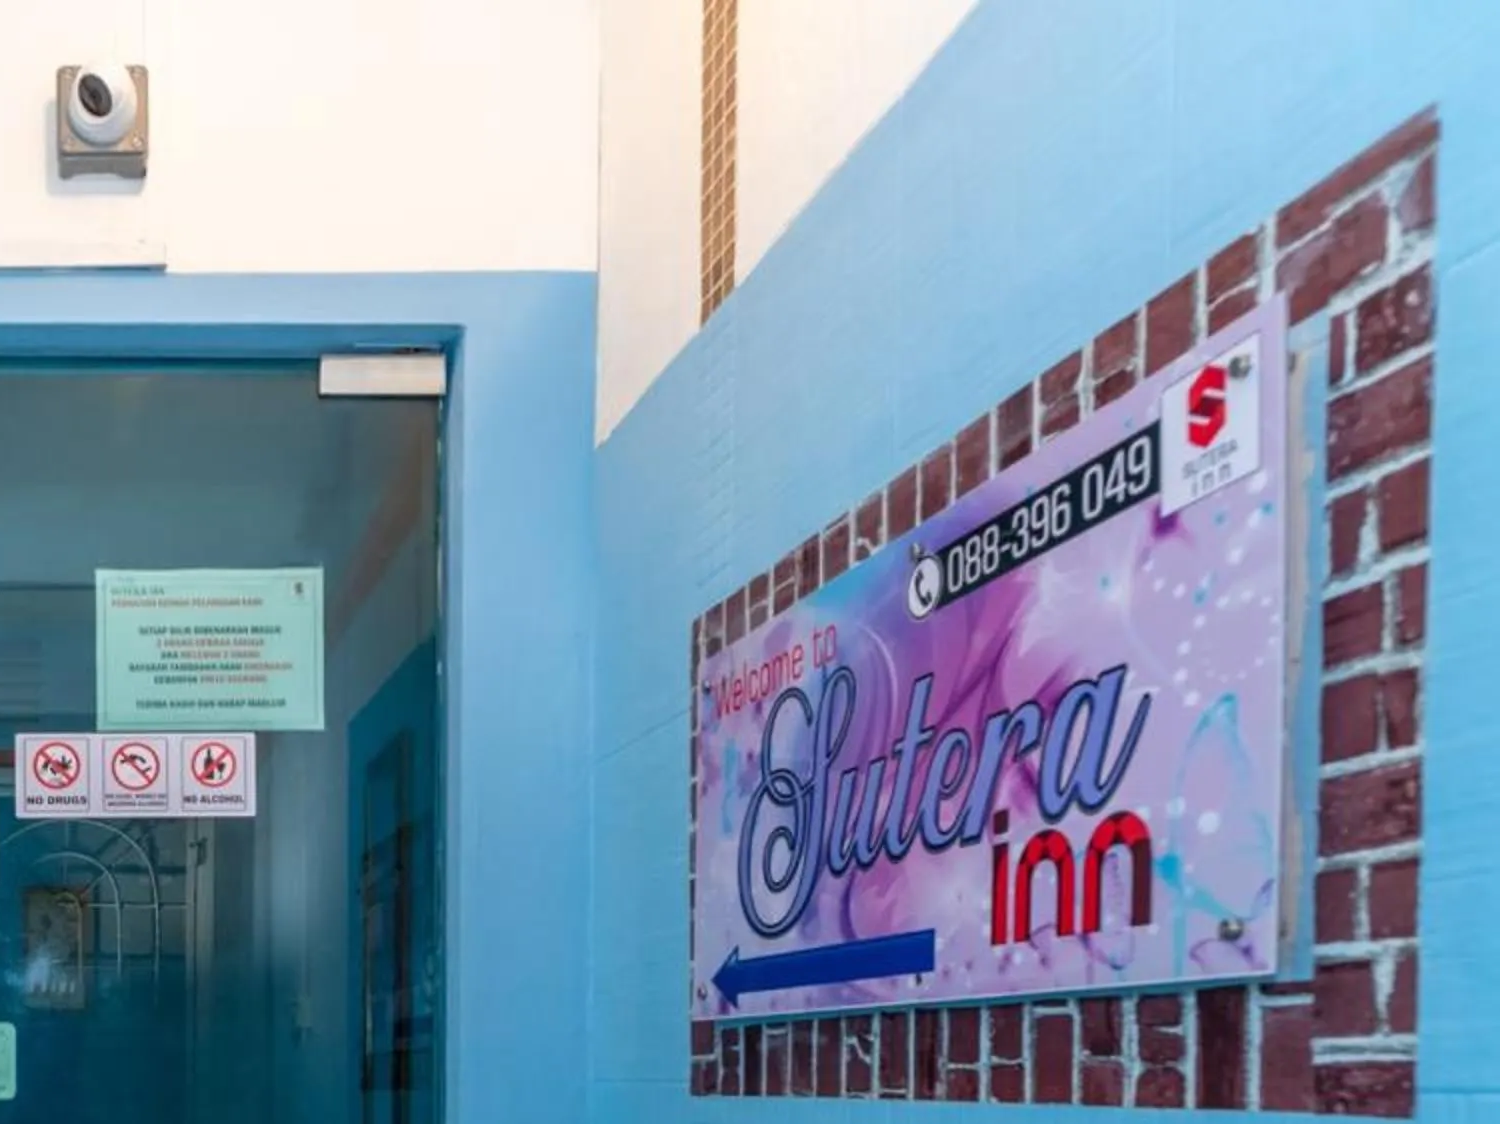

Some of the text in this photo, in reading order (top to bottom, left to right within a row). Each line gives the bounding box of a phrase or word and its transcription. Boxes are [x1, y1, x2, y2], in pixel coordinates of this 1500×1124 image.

[947, 435, 1153, 594] 088-396 049
[715, 624, 837, 718] Welcome to
[27, 795, 87, 804] NO DRUGS
[739, 663, 1152, 939] Sutera
[991, 810, 1152, 946] inn
